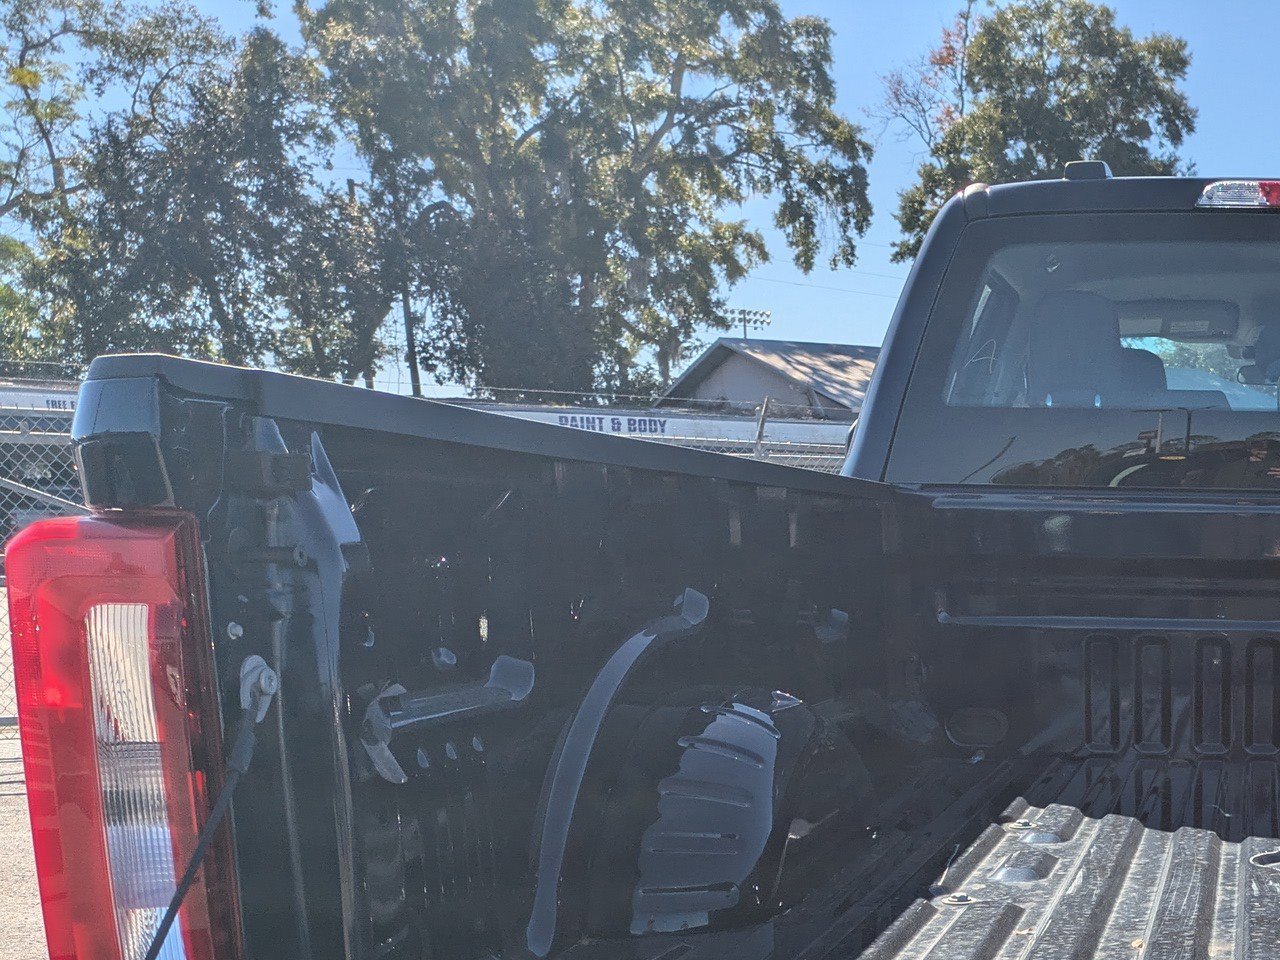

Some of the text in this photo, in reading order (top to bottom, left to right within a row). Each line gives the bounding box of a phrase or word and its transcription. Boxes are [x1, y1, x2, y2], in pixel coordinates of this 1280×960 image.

[558, 415, 667, 434] PAINT & BODY
